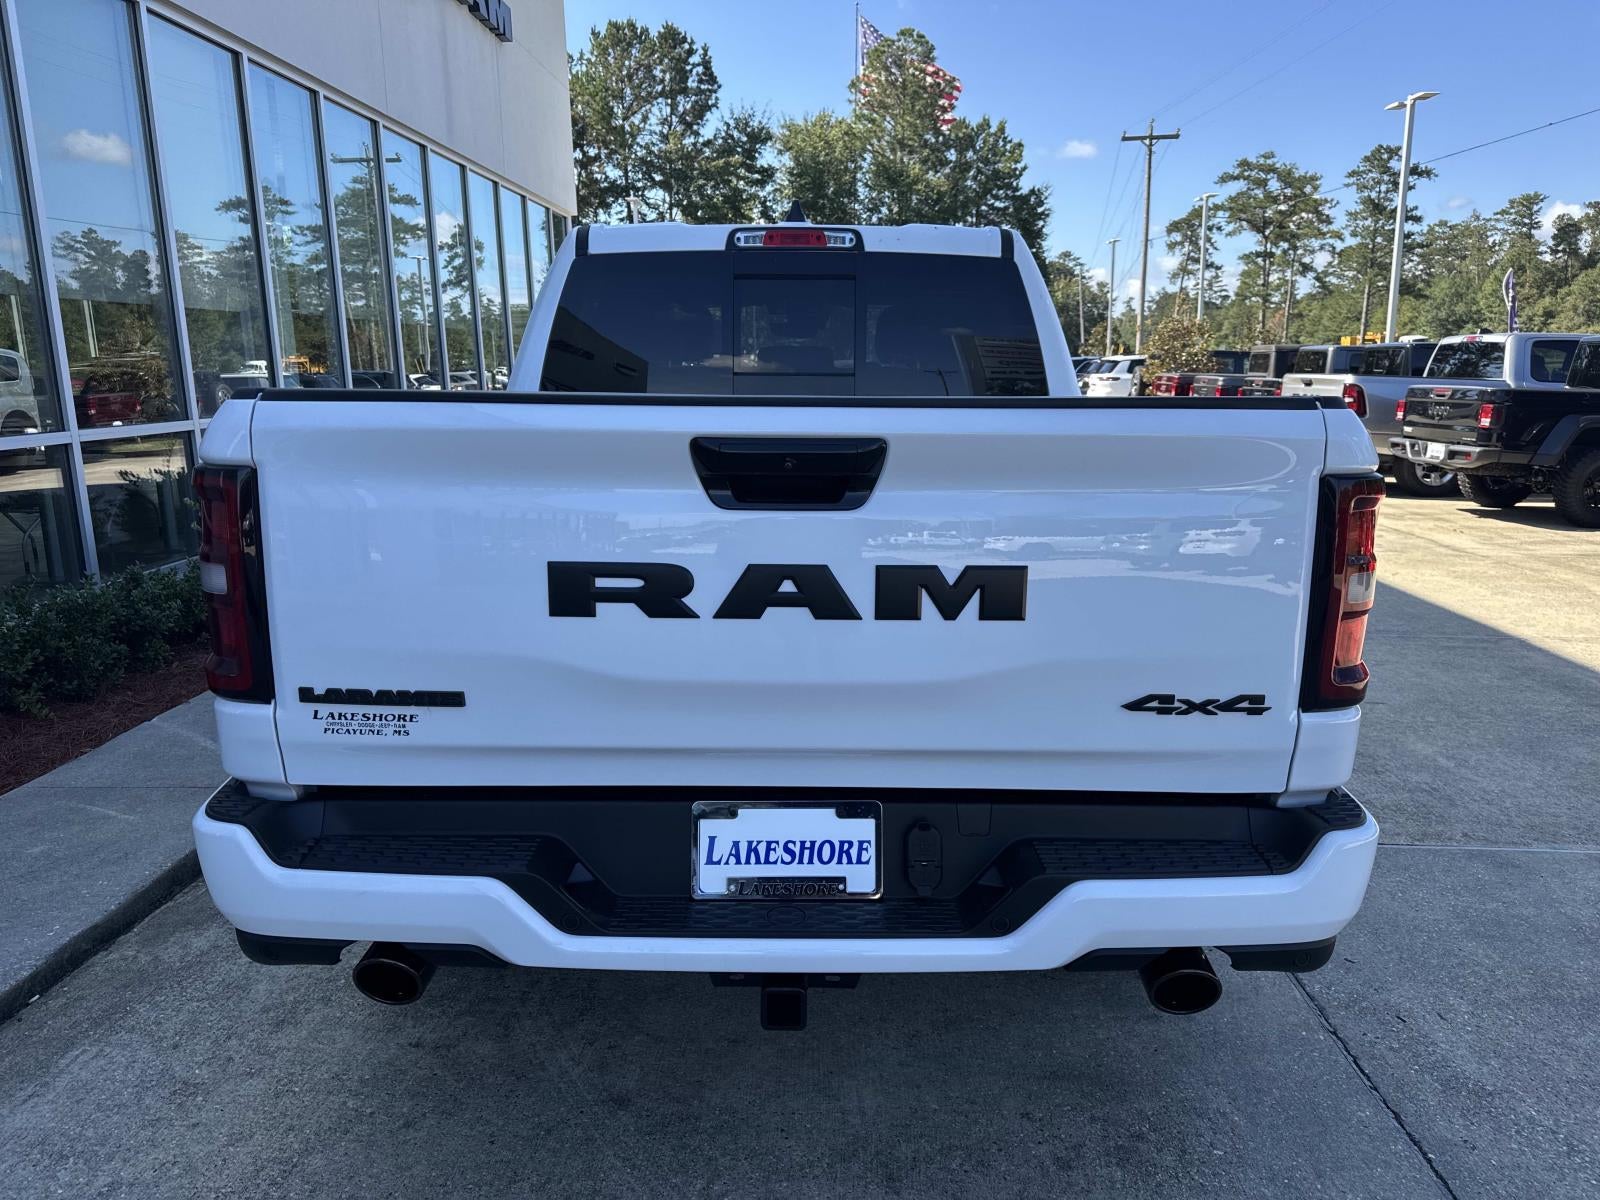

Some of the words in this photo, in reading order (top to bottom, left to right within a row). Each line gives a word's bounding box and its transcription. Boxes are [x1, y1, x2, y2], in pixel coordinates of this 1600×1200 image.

[547, 561, 1028, 621] RAM
[312, 709, 419, 723] LAKESHORE
[323, 727, 388, 737] PICAYUNE,
[392, 729, 410, 737] MS
[704, 836, 872, 866] LAKESHORE
[737, 880, 839, 896] LAKESHORE
